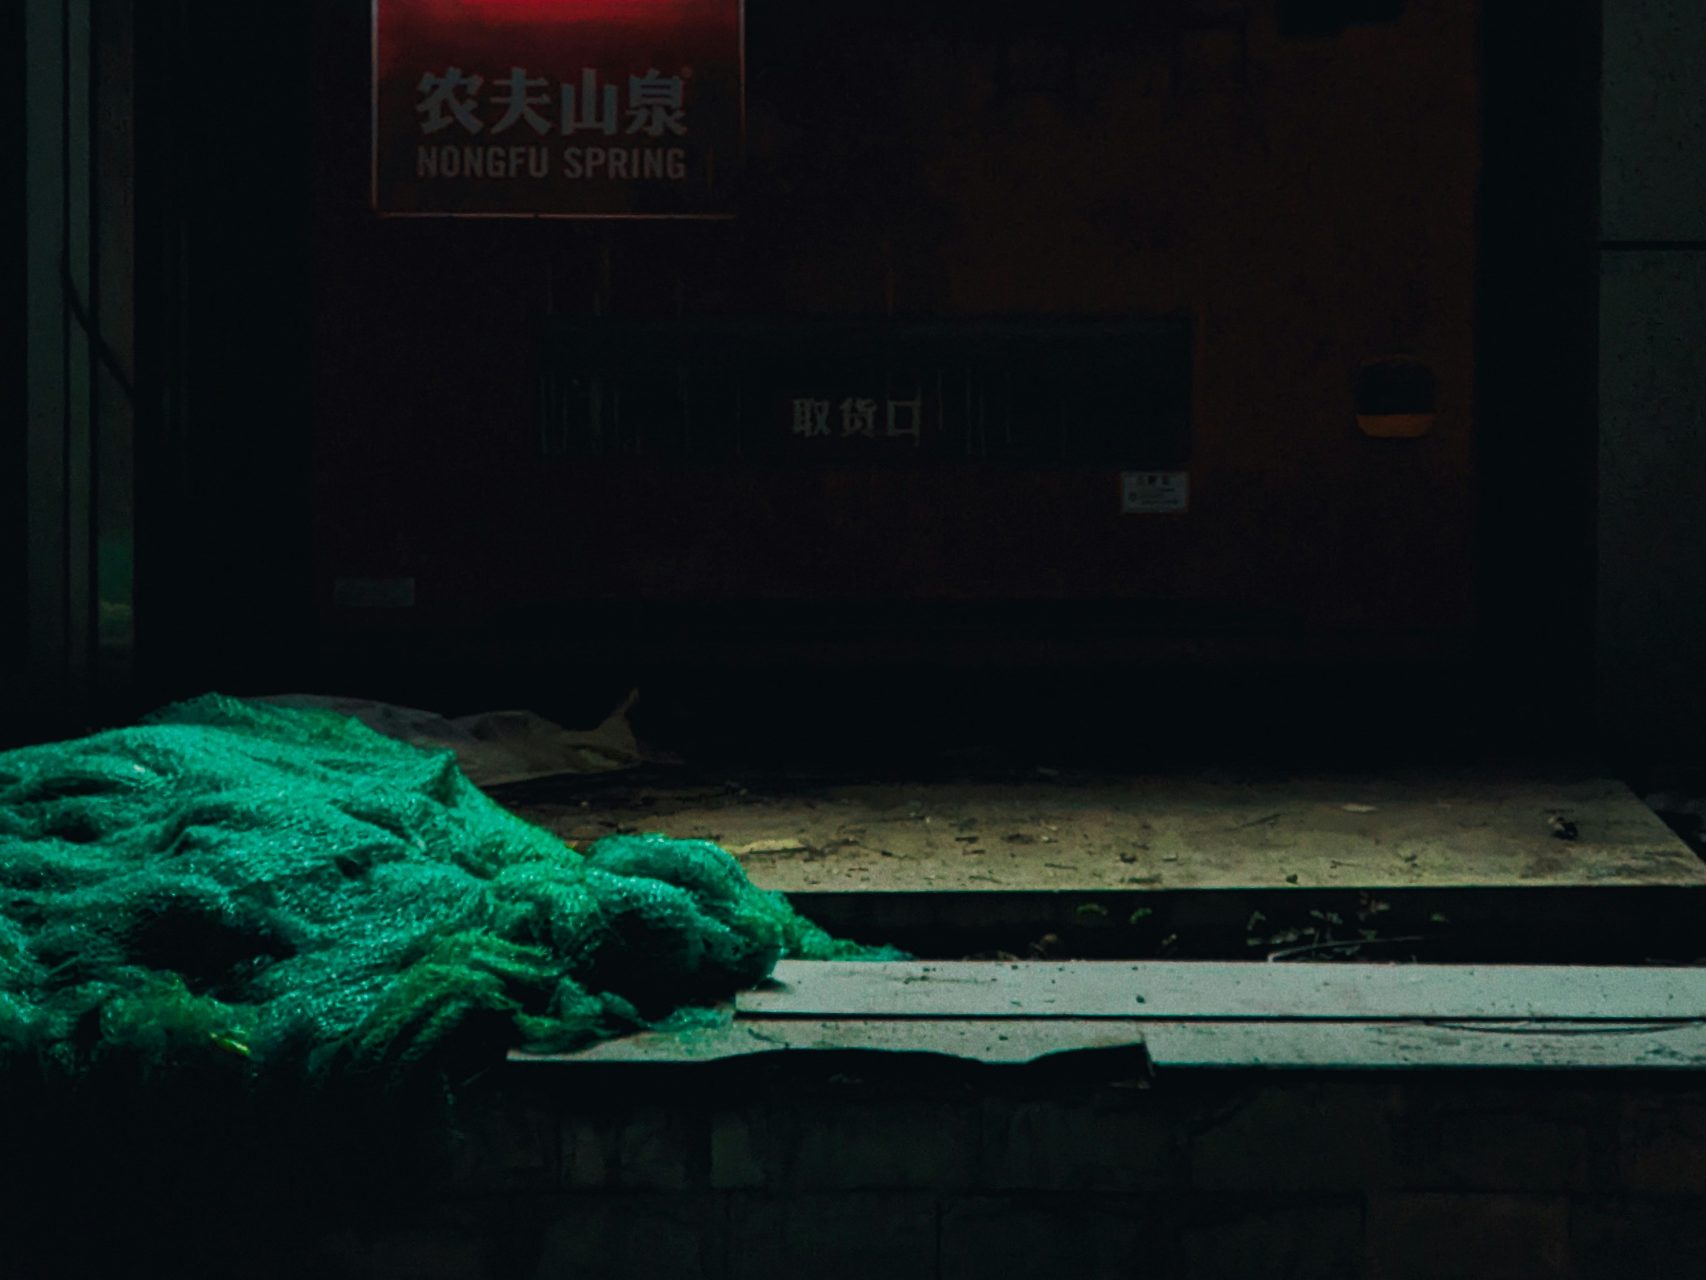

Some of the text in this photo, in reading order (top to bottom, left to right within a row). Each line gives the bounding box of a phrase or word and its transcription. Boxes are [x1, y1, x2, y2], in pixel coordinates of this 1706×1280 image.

[415, 66, 688, 138] 农夫山泉
[416, 145, 687, 180] NONGFU SPRING
[791, 396, 923, 438] 取货口
